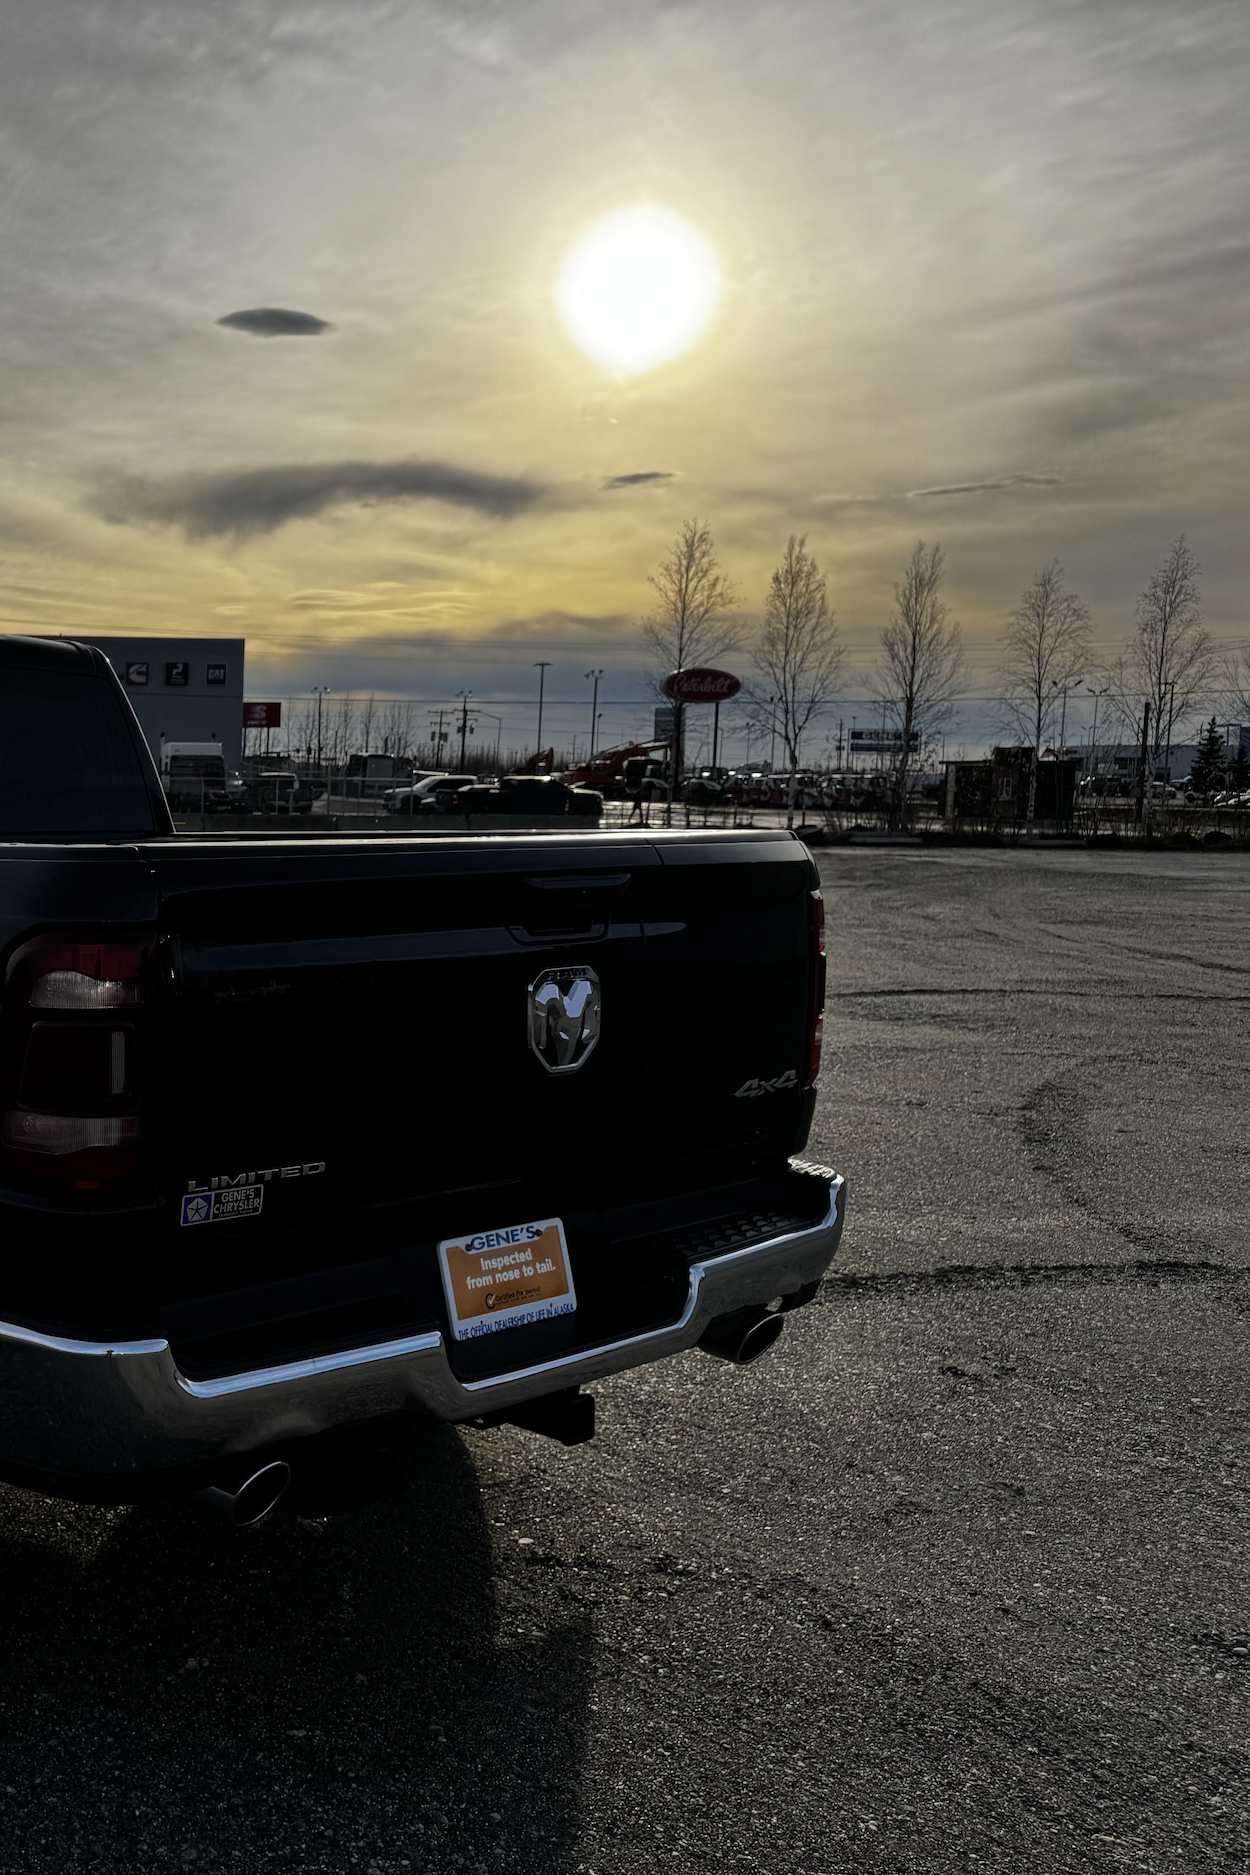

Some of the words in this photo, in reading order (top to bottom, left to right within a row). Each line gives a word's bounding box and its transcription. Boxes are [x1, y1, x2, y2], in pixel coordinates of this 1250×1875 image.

[673, 672, 734, 693] Peterbilt
[186, 1161, 326, 1193] LIMITED
[213, 1198, 260, 1215] CHRYSLER
[221, 1188, 255, 1203] GENE'S
[470, 1225, 536, 1251] GENE'S
[480, 1248, 533, 1271] Inspected
[466, 1275, 493, 1290] from
[495, 1270, 520, 1284] nose
[522, 1265, 534, 1277] to
[536, 1258, 556, 1274] tail.
[458, 1328, 470, 1340] THE
[470, 1322, 494, 1337] OFFICIAL
[494, 1316, 526, 1331] DEALERSHIP
[526, 1312, 535, 1322] OF
[536, 1308, 546, 1320] LIFE
[554, 1303, 574, 1316] ALASKA
